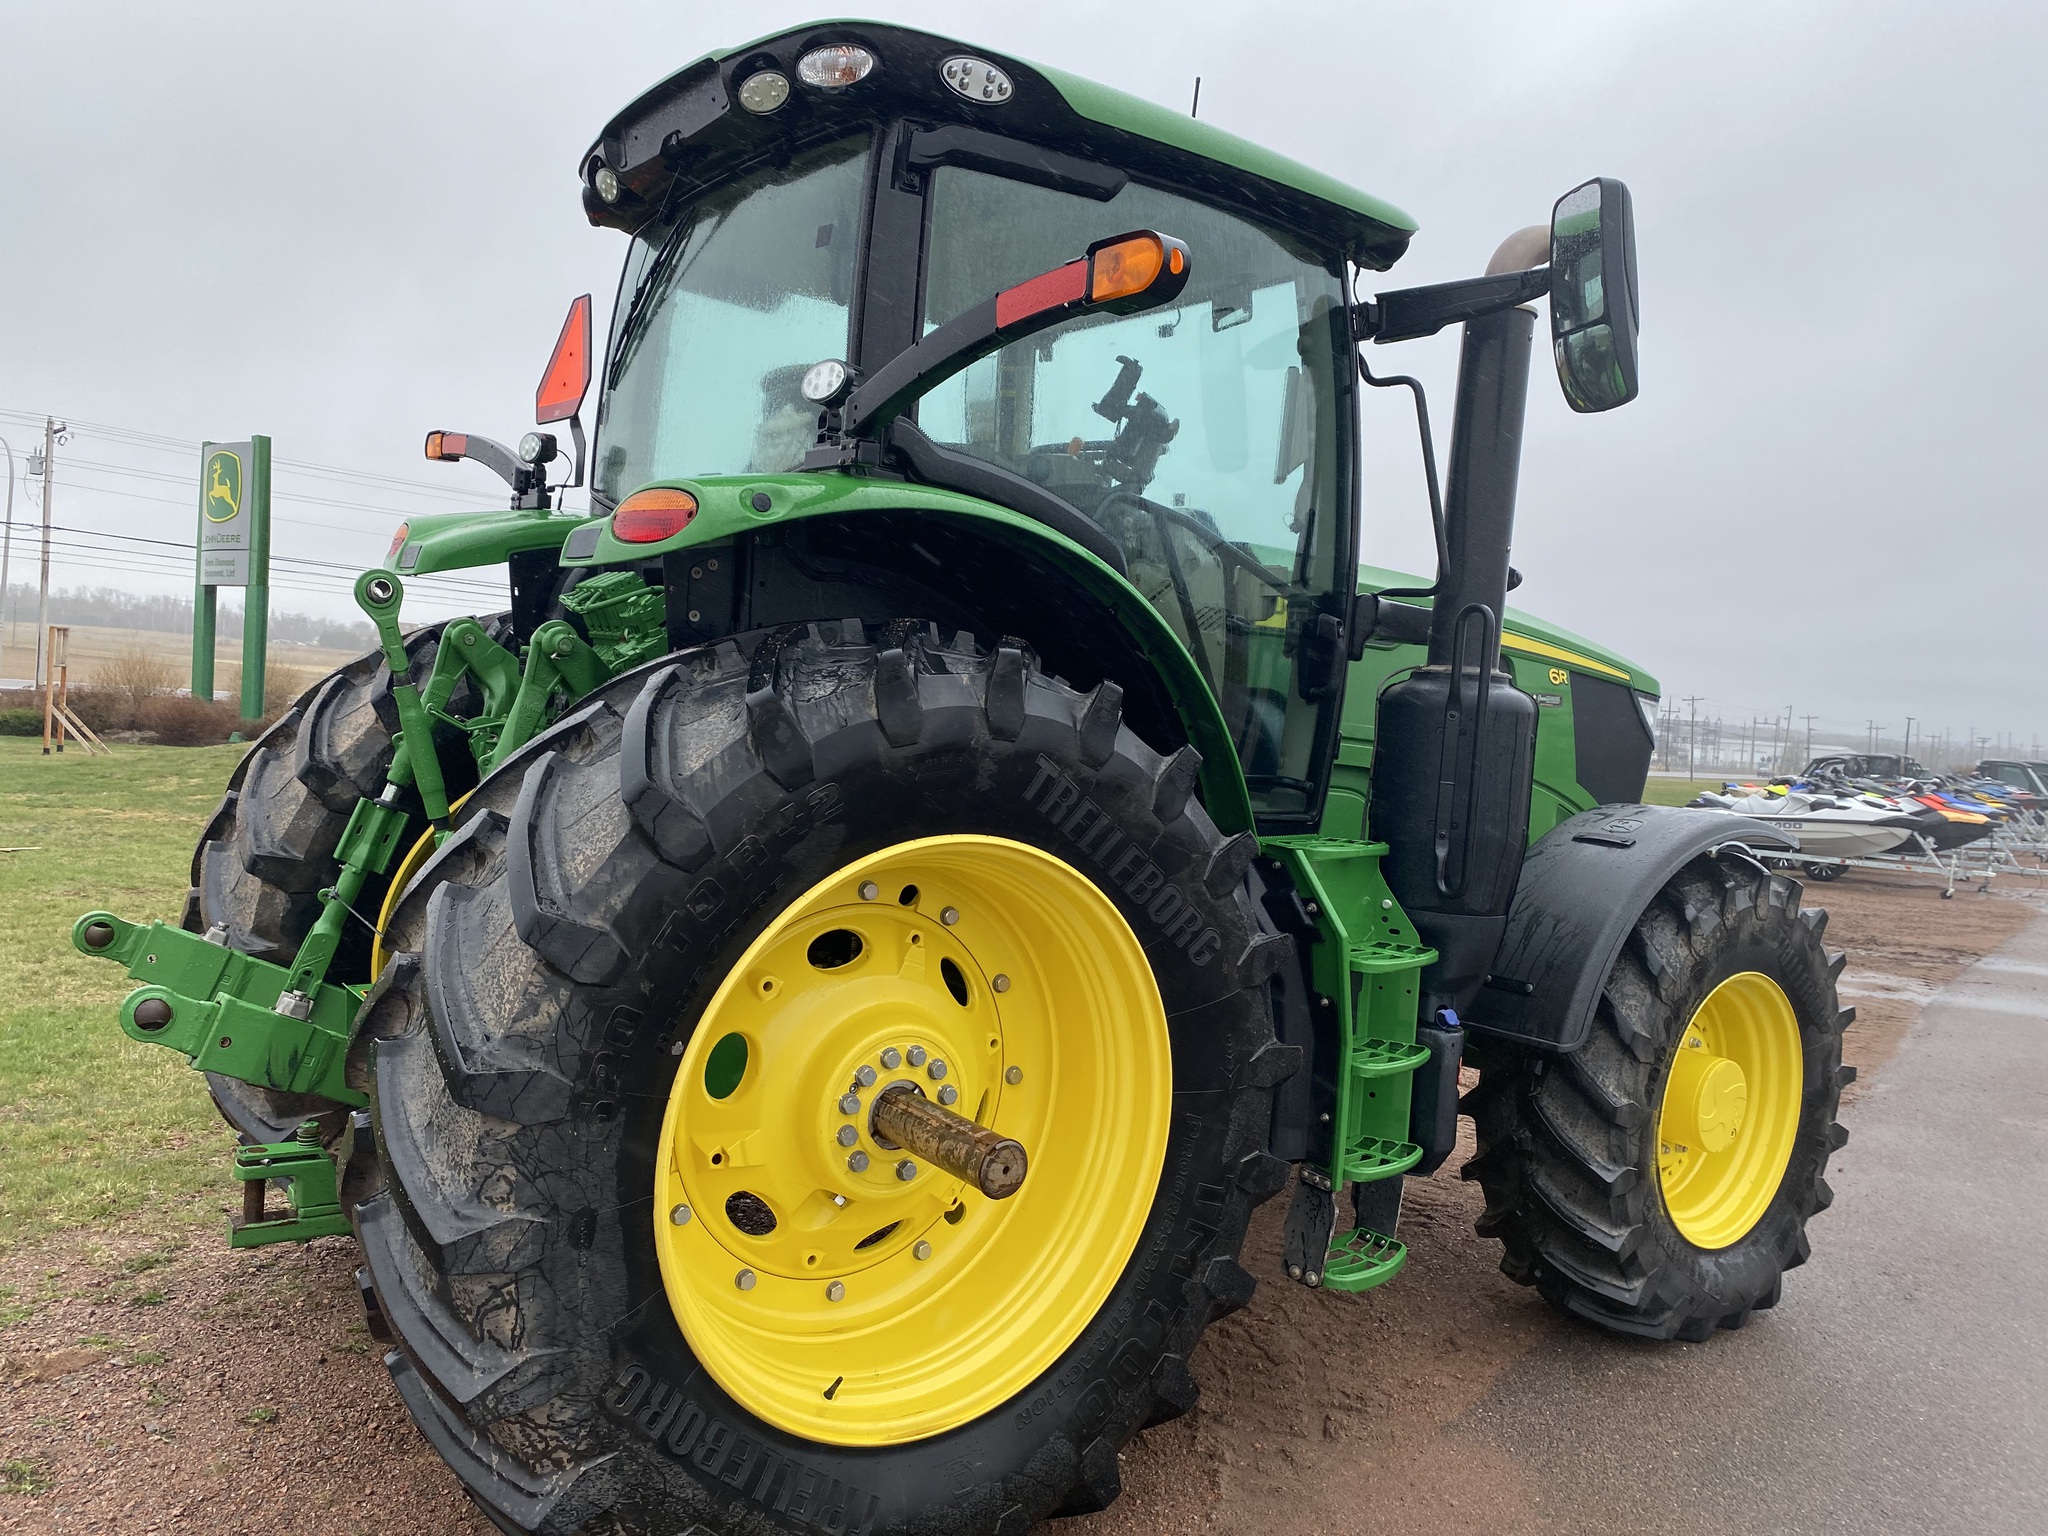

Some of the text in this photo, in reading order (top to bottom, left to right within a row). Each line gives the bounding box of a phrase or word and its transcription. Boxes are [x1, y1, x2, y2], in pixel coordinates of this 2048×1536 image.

[216, 533, 241, 544] DEERE
[1548, 667, 1569, 686] 6R
[1022, 753, 1222, 967] TRELLEBORG
